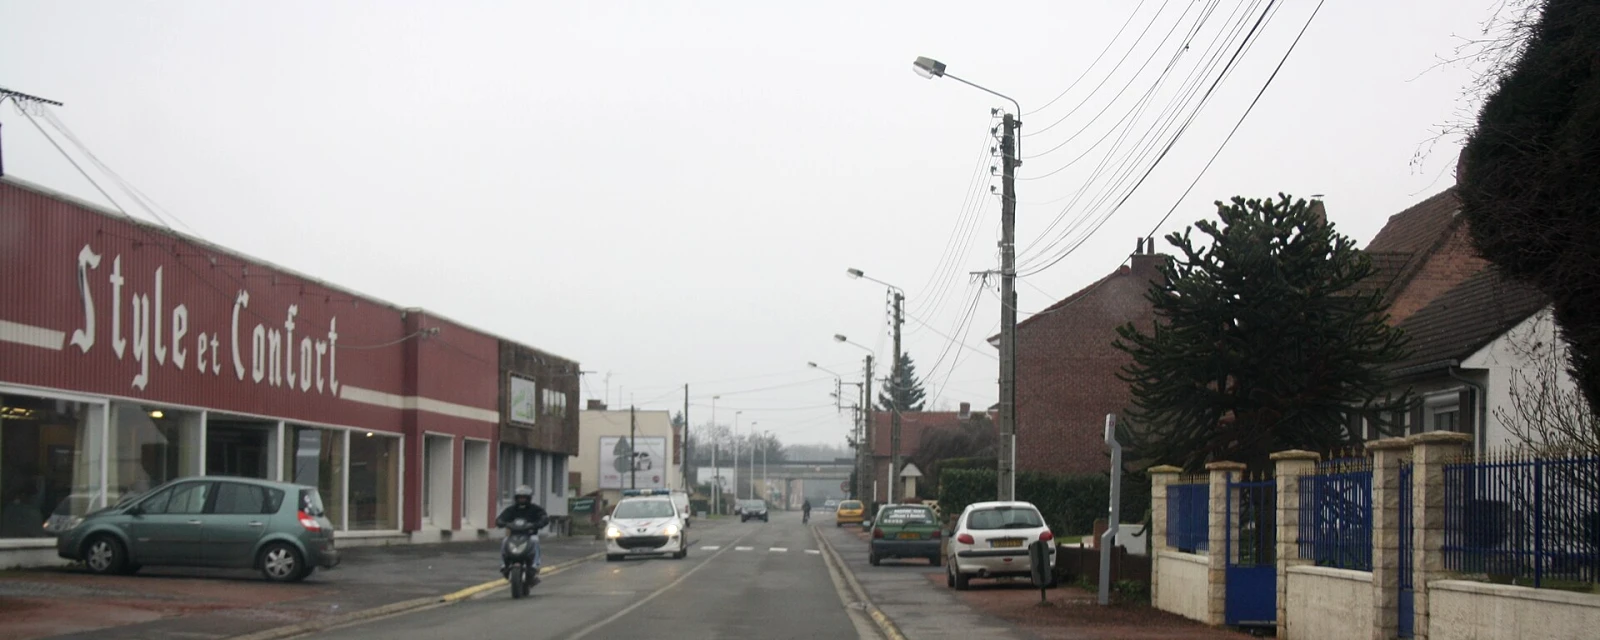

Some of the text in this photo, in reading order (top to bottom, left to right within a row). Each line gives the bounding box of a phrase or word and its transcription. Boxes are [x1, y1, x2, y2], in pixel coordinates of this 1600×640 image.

[70, 244, 338, 397] Style et Confort
